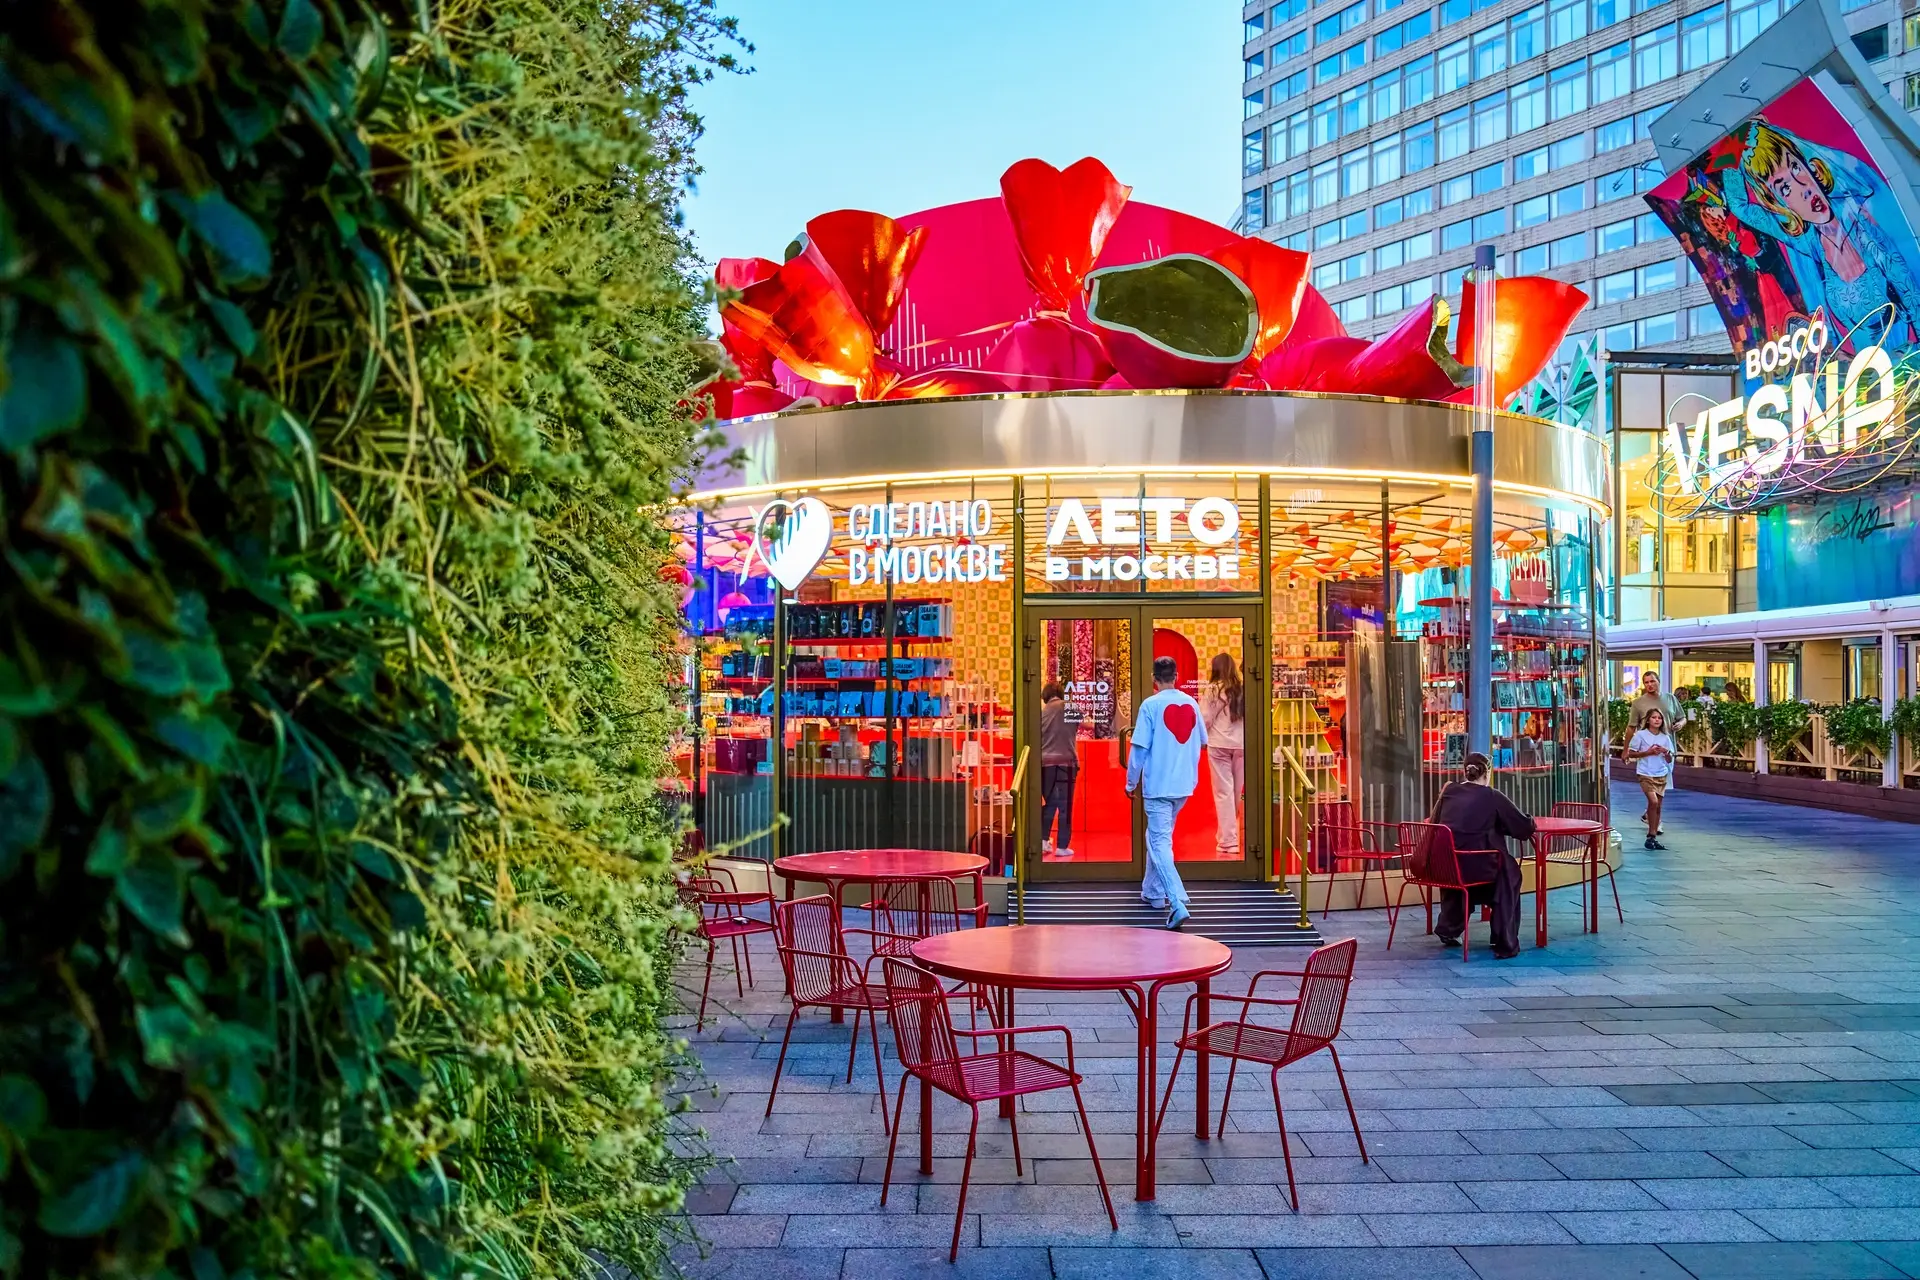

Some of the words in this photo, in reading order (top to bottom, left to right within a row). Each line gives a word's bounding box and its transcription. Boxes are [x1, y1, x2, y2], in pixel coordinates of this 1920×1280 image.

[1746, 320, 1829, 380] BOSCO
[1665, 345, 1896, 496] VESNA
[849, 499, 993, 546] СДЕЛАНО
[1046, 496, 1239, 545] ЛЕТО
[849, 548, 868, 585] В
[874, 543, 1007, 584] МОСКВЕ
[1046, 556, 1070, 581] В
[1082, 555, 1239, 581] МОСКВЕ
[1064, 681, 1109, 693] ЛЕТО
